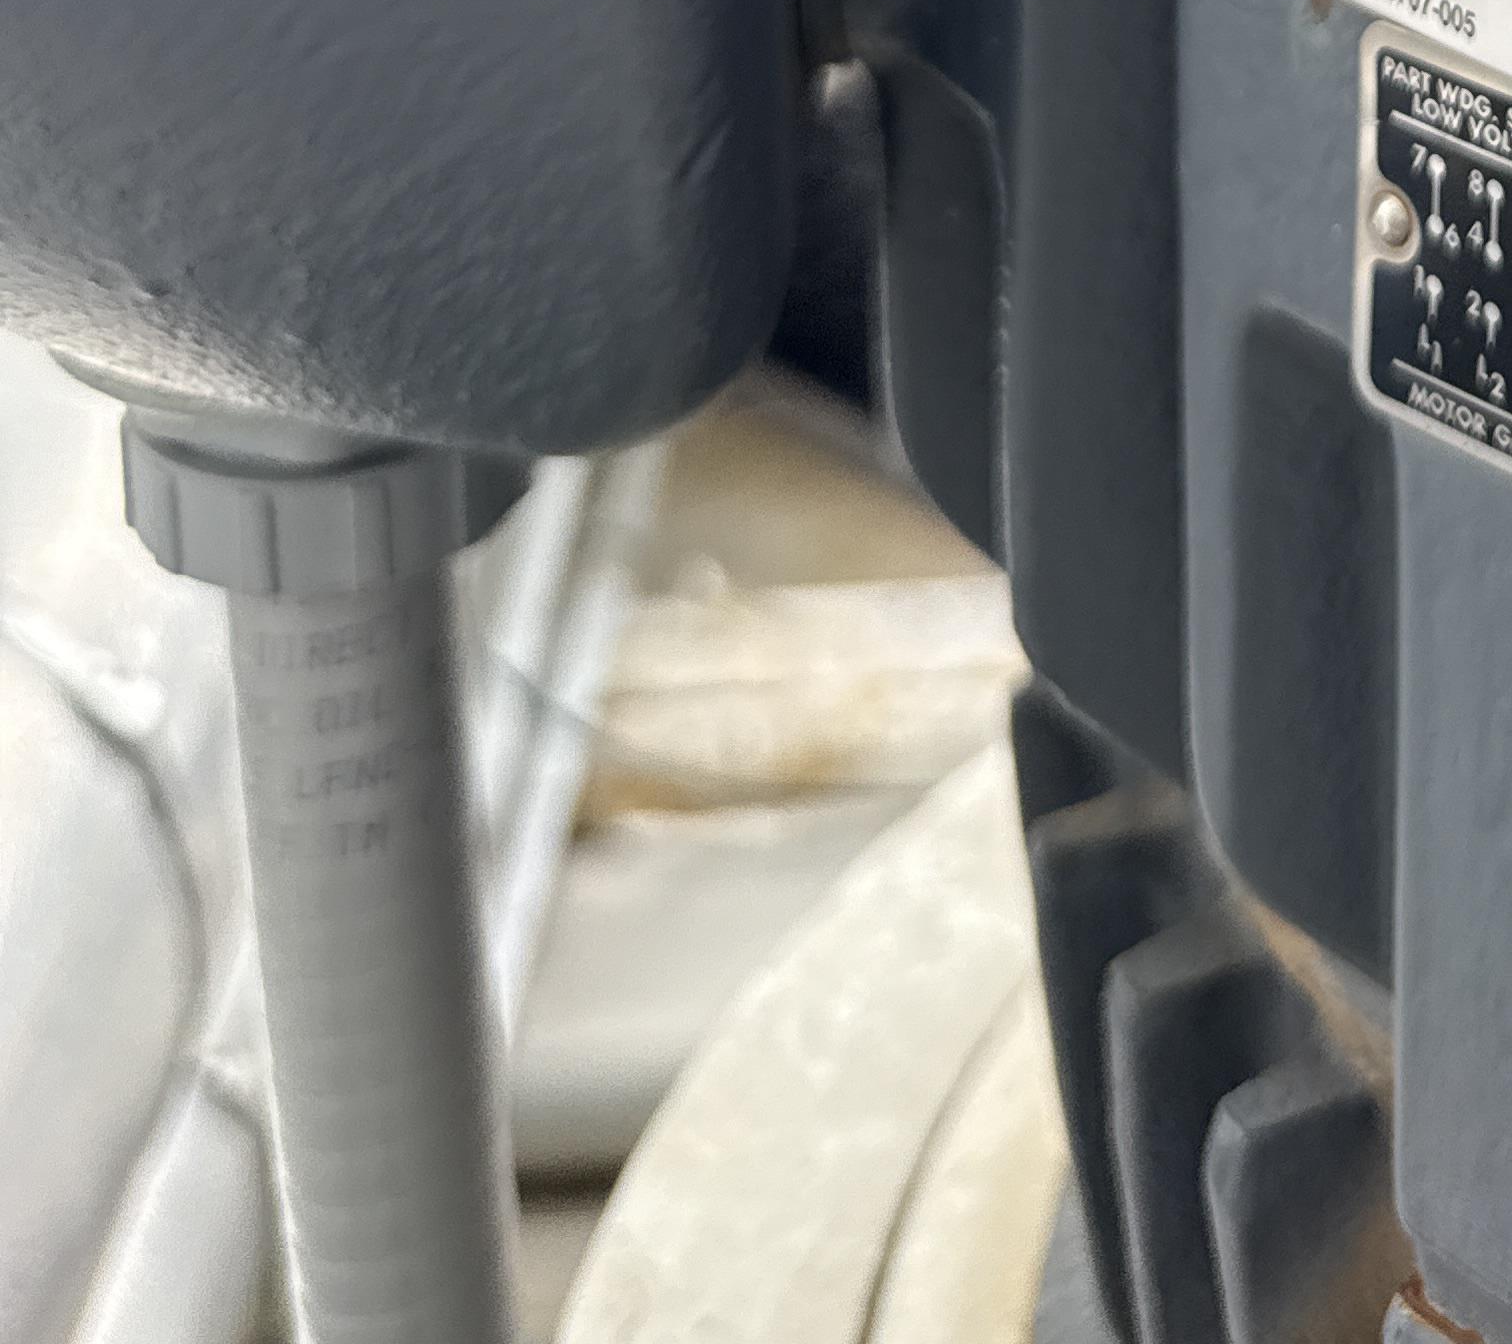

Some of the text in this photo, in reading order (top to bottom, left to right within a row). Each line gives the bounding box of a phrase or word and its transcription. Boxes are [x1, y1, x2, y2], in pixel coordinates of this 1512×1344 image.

[1381, 56, 1432, 95] PART
[1411, 93, 1463, 132] LOW
[1408, 382, 1488, 441] MOTOR
